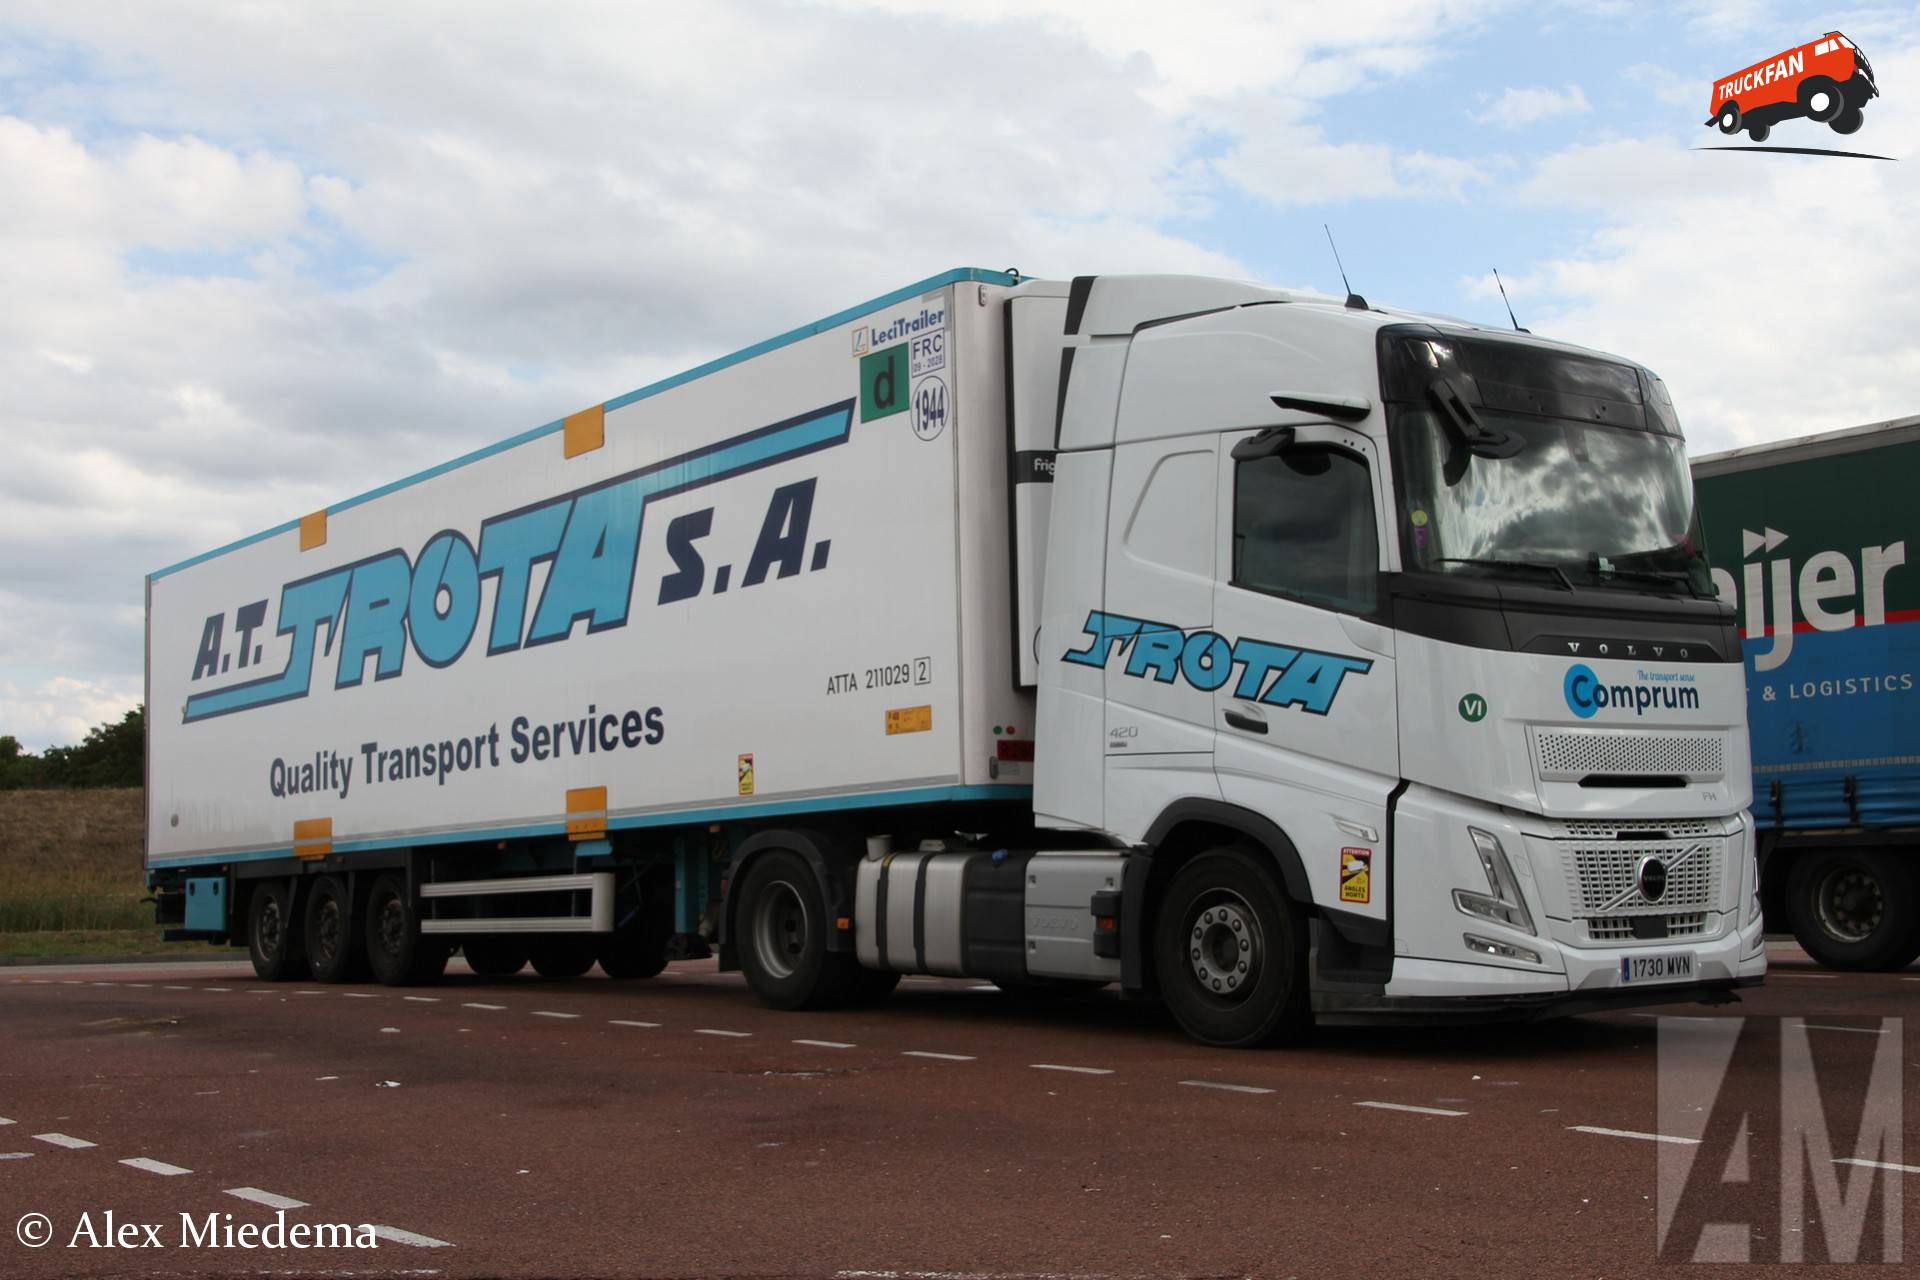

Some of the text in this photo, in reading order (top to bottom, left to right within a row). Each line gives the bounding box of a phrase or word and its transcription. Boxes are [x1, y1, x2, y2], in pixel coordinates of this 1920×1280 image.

[871, 310, 944, 347] LeciTrailer
[913, 334, 942, 361] FRC
[874, 355, 895, 410] d
[916, 386, 945, 432] 1944
[191, 598, 269, 681] A.T.
[657, 476, 832, 606] S.A.
[1061, 609, 1375, 716] TROTA
[1567, 642, 1689, 658] VOLVO
[826, 661, 927, 695] ATTA 211029 2
[1571, 674, 1700, 716] Comprum
[1762, 673, 1913, 701] & LOGISTICS
[1464, 699, 1483, 717] VI
[1109, 726, 1138, 739] 420
[270, 704, 665, 799] Quality Transport Services
[1633, 955, 1690, 978] 1730 MVN
